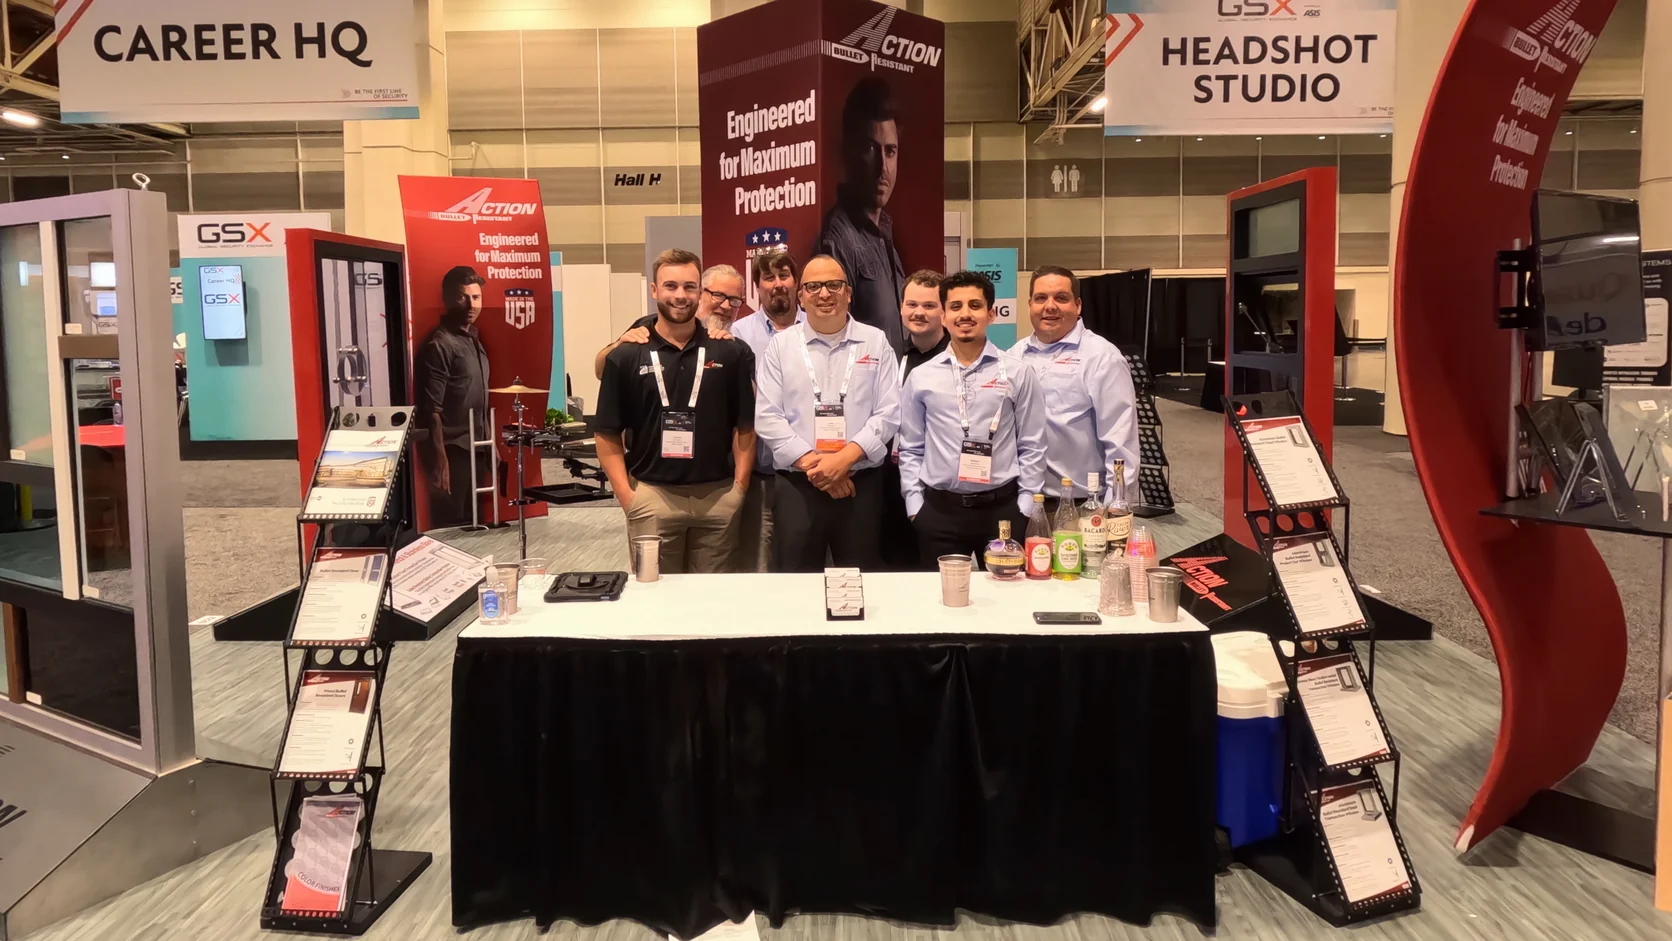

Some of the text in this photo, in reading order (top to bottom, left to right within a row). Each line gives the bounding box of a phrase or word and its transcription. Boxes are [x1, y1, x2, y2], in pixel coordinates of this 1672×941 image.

[1217, 0, 1297, 17] GSX
[93, 20, 373, 67] CAREER HQ
[839, 5, 943, 67] ACTION
[1513, 36, 1538, 57] BULLET
[833, 46, 864, 61] BULLET
[1162, 34, 1378, 66] HEADSHOT
[870, 52, 915, 73] RESISTANT
[1193, 73, 1341, 104] STUDIO
[1511, 77, 1556, 119] Engineered
[727, 89, 816, 143] Engineered
[719, 139, 816, 181] for Maximum
[614, 173, 662, 186] Hall H
[1490, 154, 1529, 190] Protection
[444, 187, 538, 215] ACTION
[735, 177, 816, 216] Protection
[197, 222, 273, 244] GSX
[479, 232, 539, 249] Engineered
[474, 249, 541, 263] for Maximum
[355, 272, 383, 286] GS
[487, 265, 543, 279] Protection
[170, 282, 183, 296] GS
[204, 293, 241, 305] GSX
[504, 301, 536, 330] USA
[297, 871, 339, 891] COLOR FINISHES
